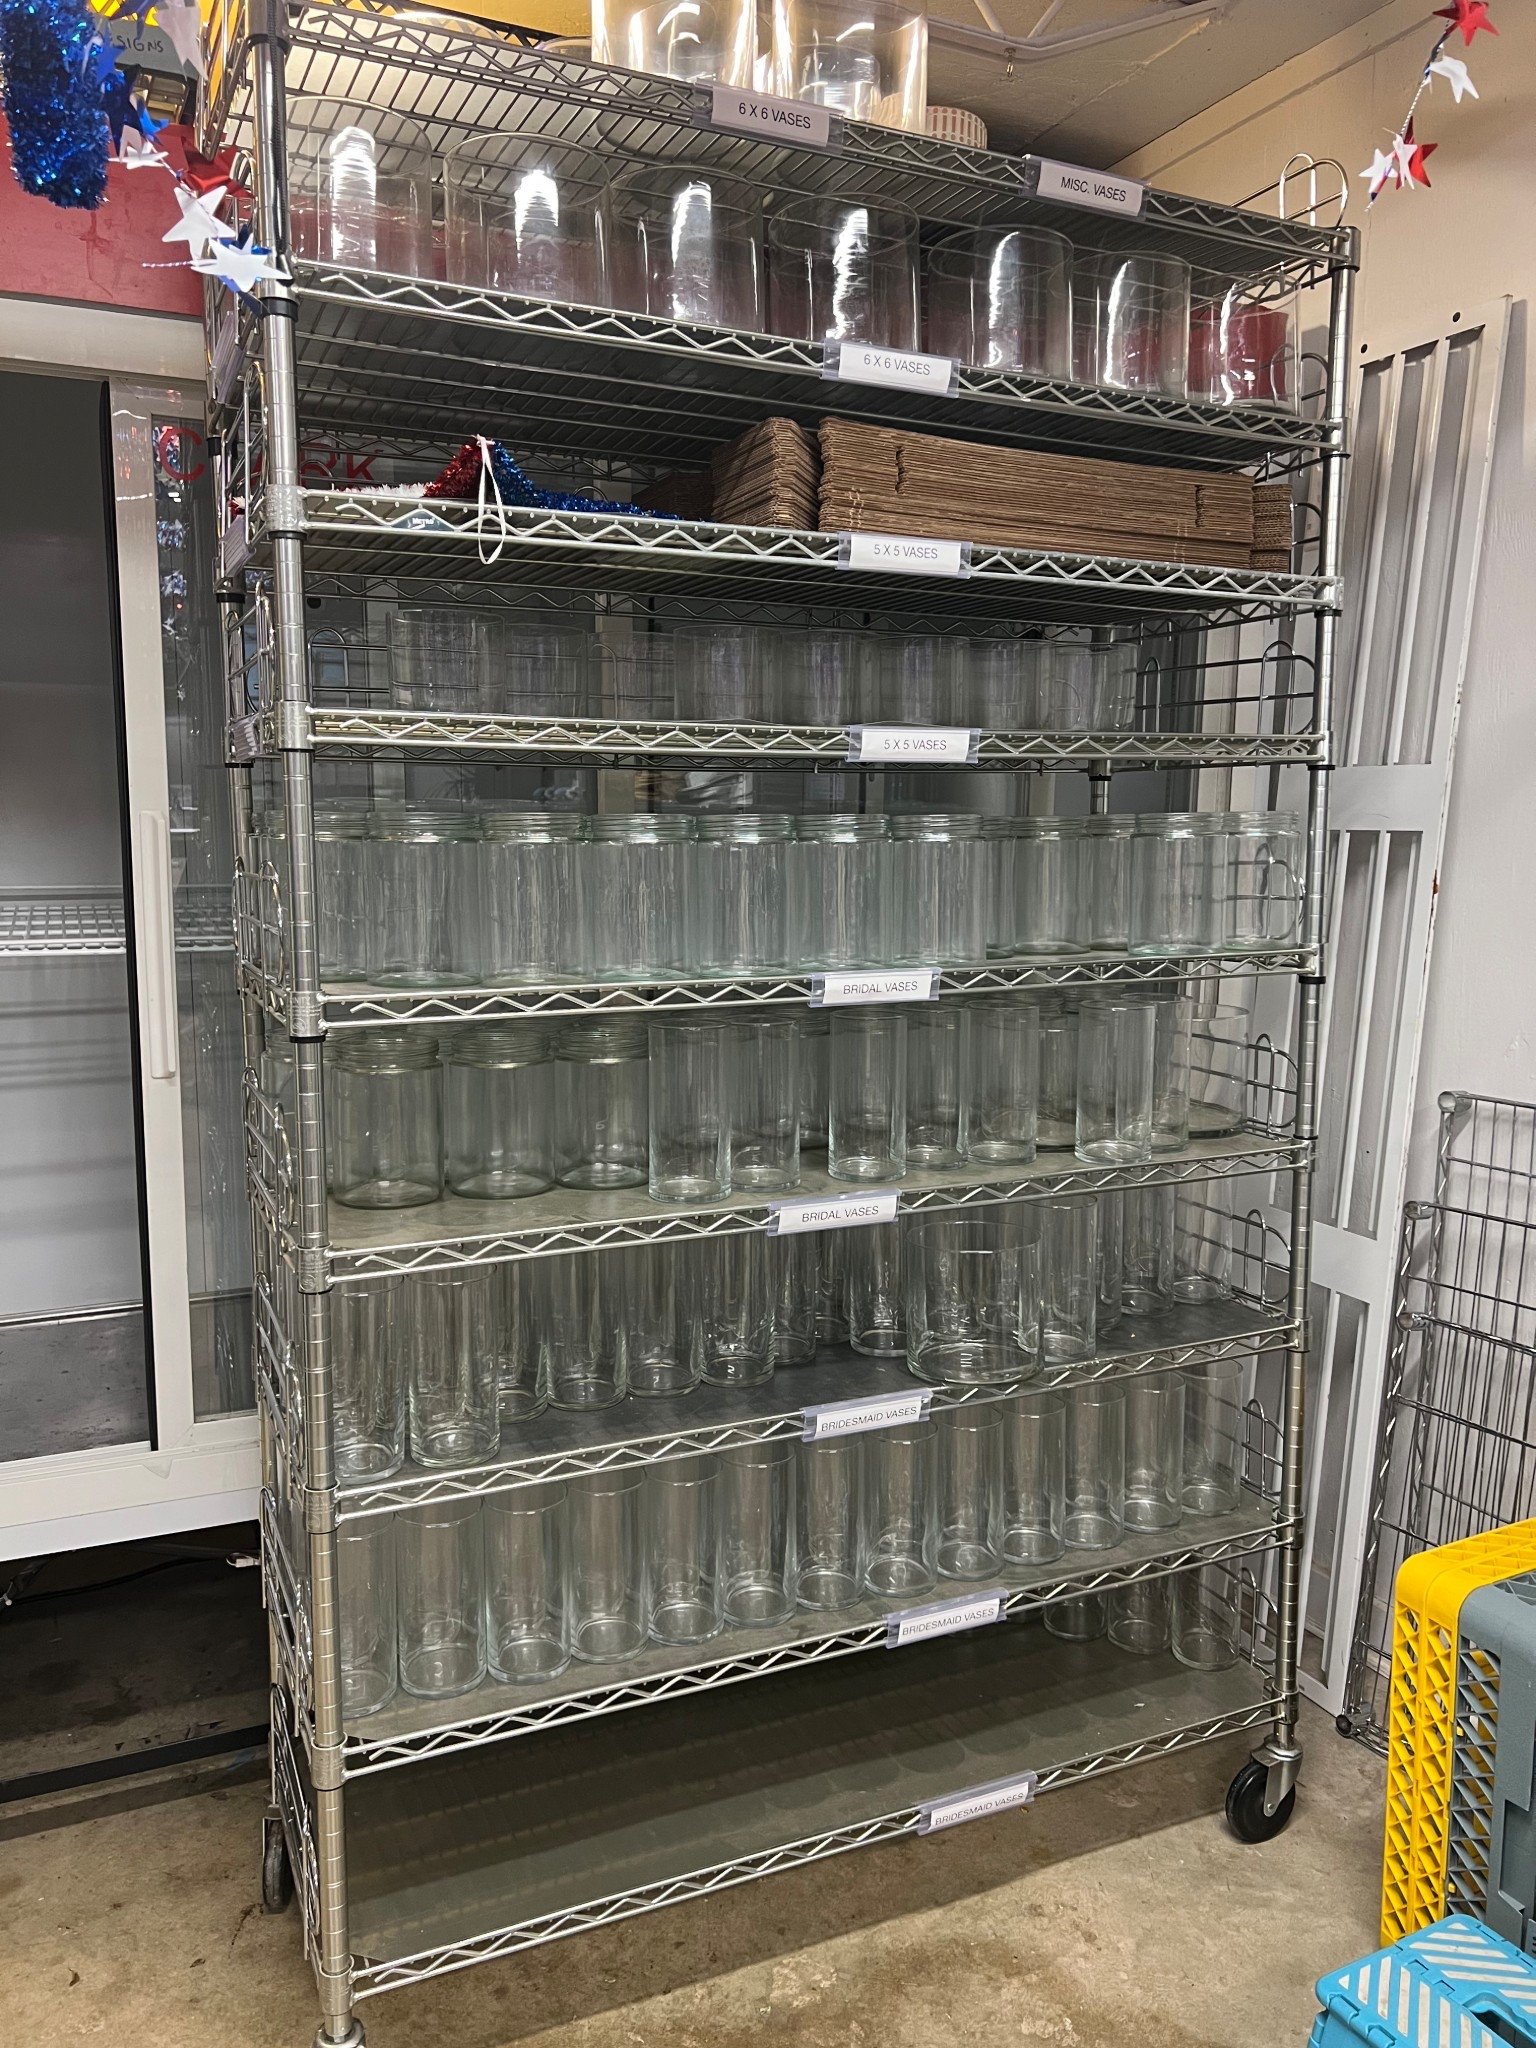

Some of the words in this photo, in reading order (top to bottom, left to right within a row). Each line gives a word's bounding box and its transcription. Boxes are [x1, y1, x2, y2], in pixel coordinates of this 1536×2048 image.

[739, 102, 746, 114] 6
[750, 103, 757, 118] X
[761, 107, 768, 119] 6
[771, 109, 811, 129] VASES
[1060, 177, 1090, 194] MISC.
[1093, 184, 1127, 202] VASES
[864, 354, 870, 365] 6
[874, 355, 881, 367] X
[884, 358, 890, 368] 6
[894, 359, 931, 375] VASES
[874, 544, 880, 554] 5
[883, 545, 891, 556] X
[894, 545, 900, 556] 5
[903, 546, 938, 559] VASES
[884, 739, 890, 750] 5
[893, 739, 901, 750] X
[903, 739, 910, 750] 5
[913, 740, 947, 750] VASES
[843, 983, 882, 995] BRIDAL
[885, 981, 918, 992] VASES
[802, 1210, 841, 1222] BRIDAL
[844, 1206, 879, 1218] VASES
[821, 1412, 883, 1431] BRIDESMAID
[885, 1406, 917, 1419] VASES
[902, 1615, 962, 1636] BRIDESMAID
[964, 1608, 994, 1620] VASES
[935, 1802, 993, 1825] BRIDESMAID
[994, 1793, 1024, 1807] VASES
